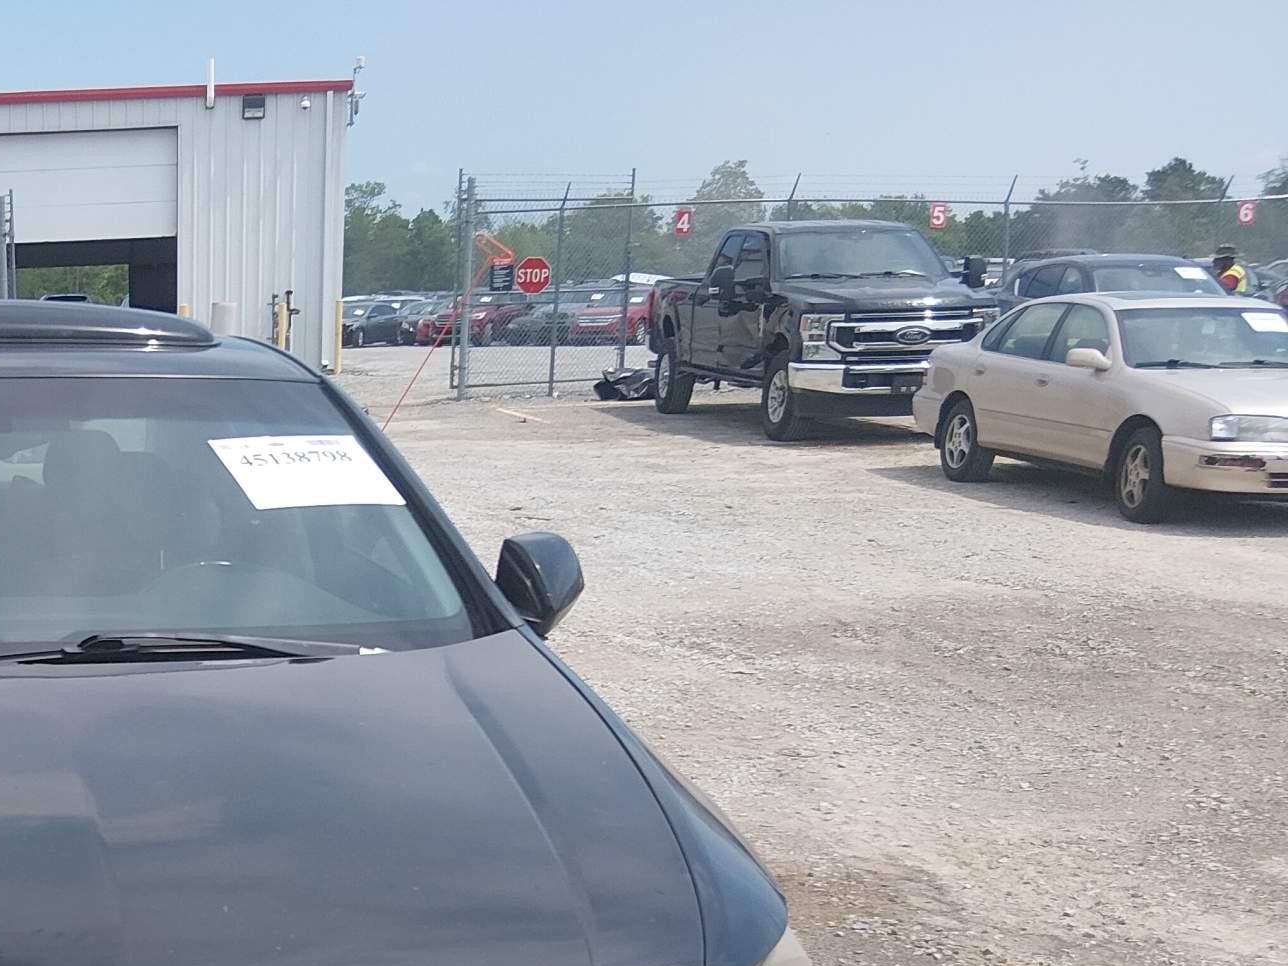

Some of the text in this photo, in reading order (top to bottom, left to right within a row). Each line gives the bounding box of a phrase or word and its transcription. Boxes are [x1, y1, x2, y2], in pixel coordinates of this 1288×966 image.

[932, 206, 945, 225] 5
[1239, 203, 1253, 222] 6
[676, 213, 690, 232] 4
[517, 268, 549, 283] STOP
[240, 450, 353, 466] 45138798
